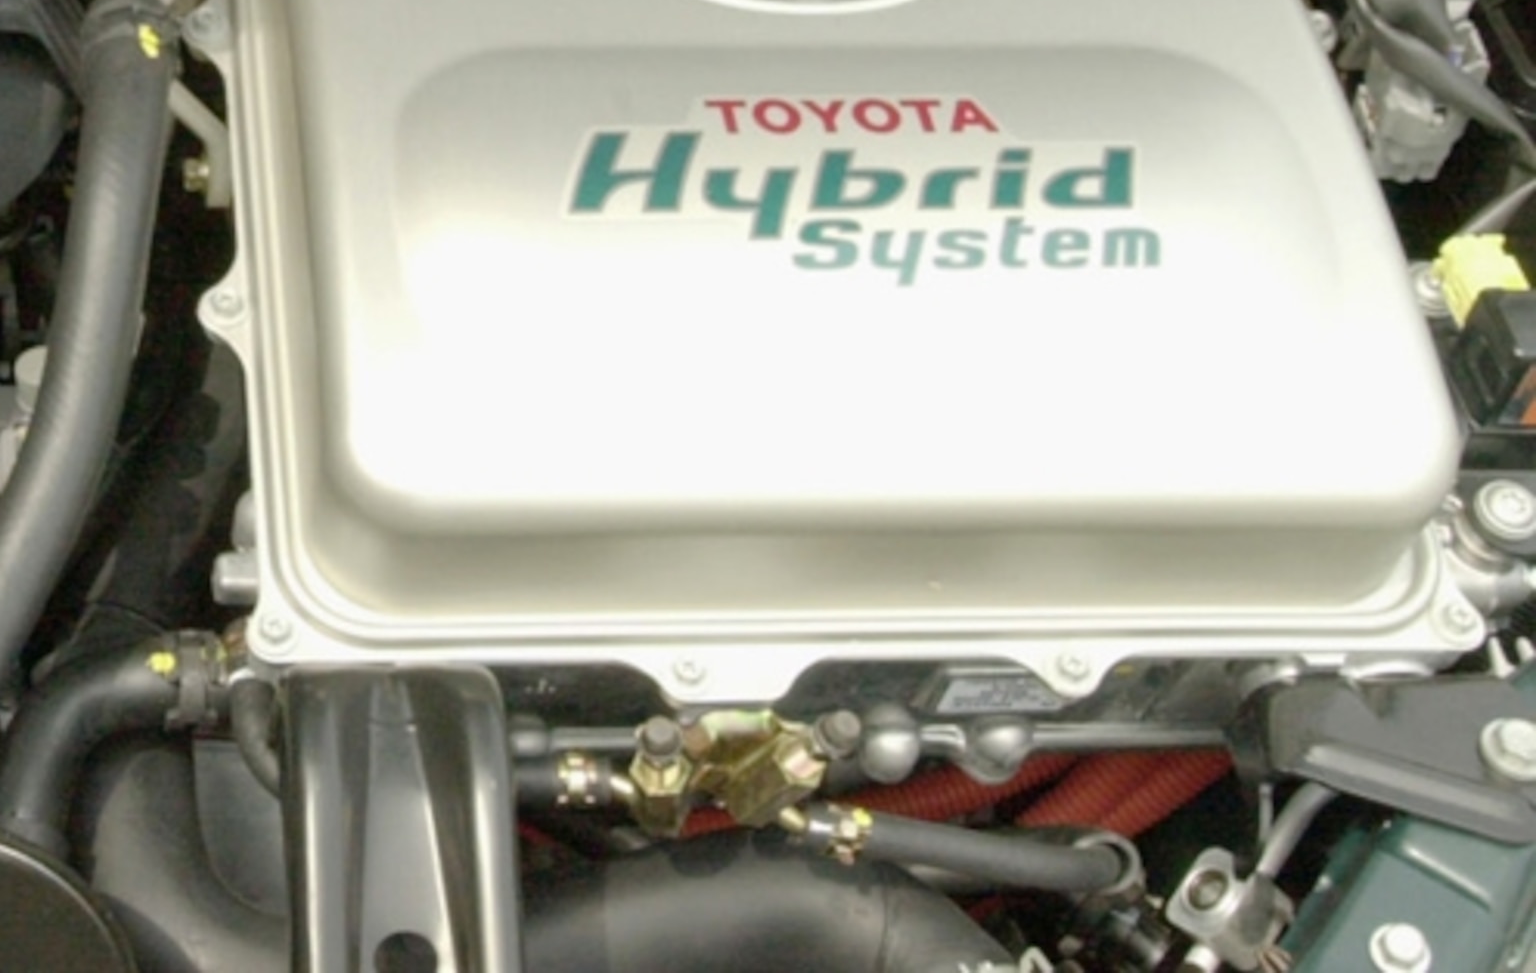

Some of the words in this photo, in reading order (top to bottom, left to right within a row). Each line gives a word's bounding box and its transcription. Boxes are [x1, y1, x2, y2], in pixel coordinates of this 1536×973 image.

[704, 98, 1000, 134] TOYOTA
[568, 131, 1135, 240] Hybrid
[792, 216, 1162, 286] System
